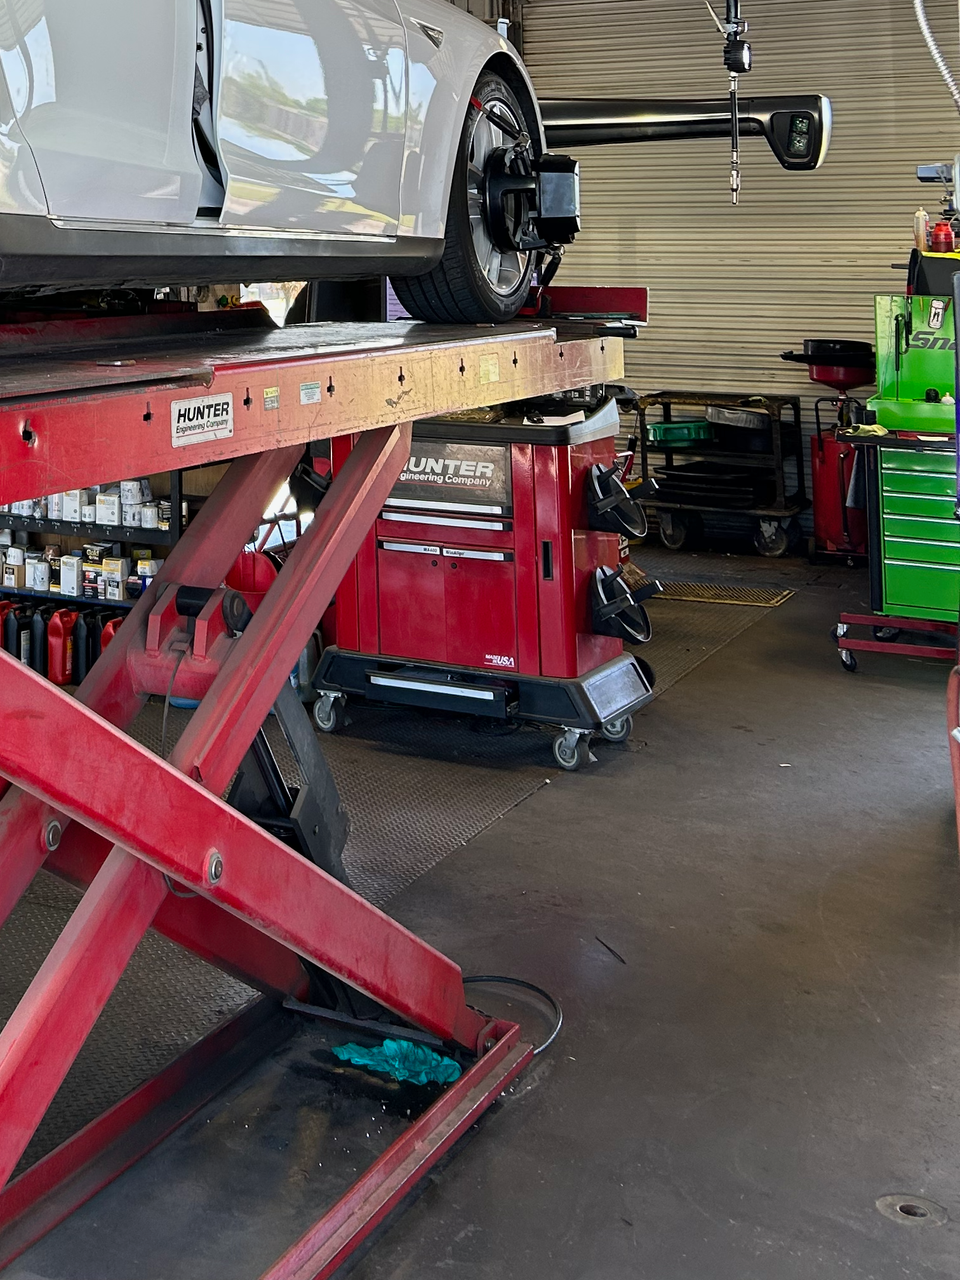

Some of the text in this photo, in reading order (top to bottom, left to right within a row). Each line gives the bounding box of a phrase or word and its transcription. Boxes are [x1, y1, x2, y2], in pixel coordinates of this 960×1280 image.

[176, 401, 230, 424] HUNTER
[175, 418, 229, 434] Engineering Company
[398, 471, 492, 487] gineering Company
[497, 656, 515, 666] USA
